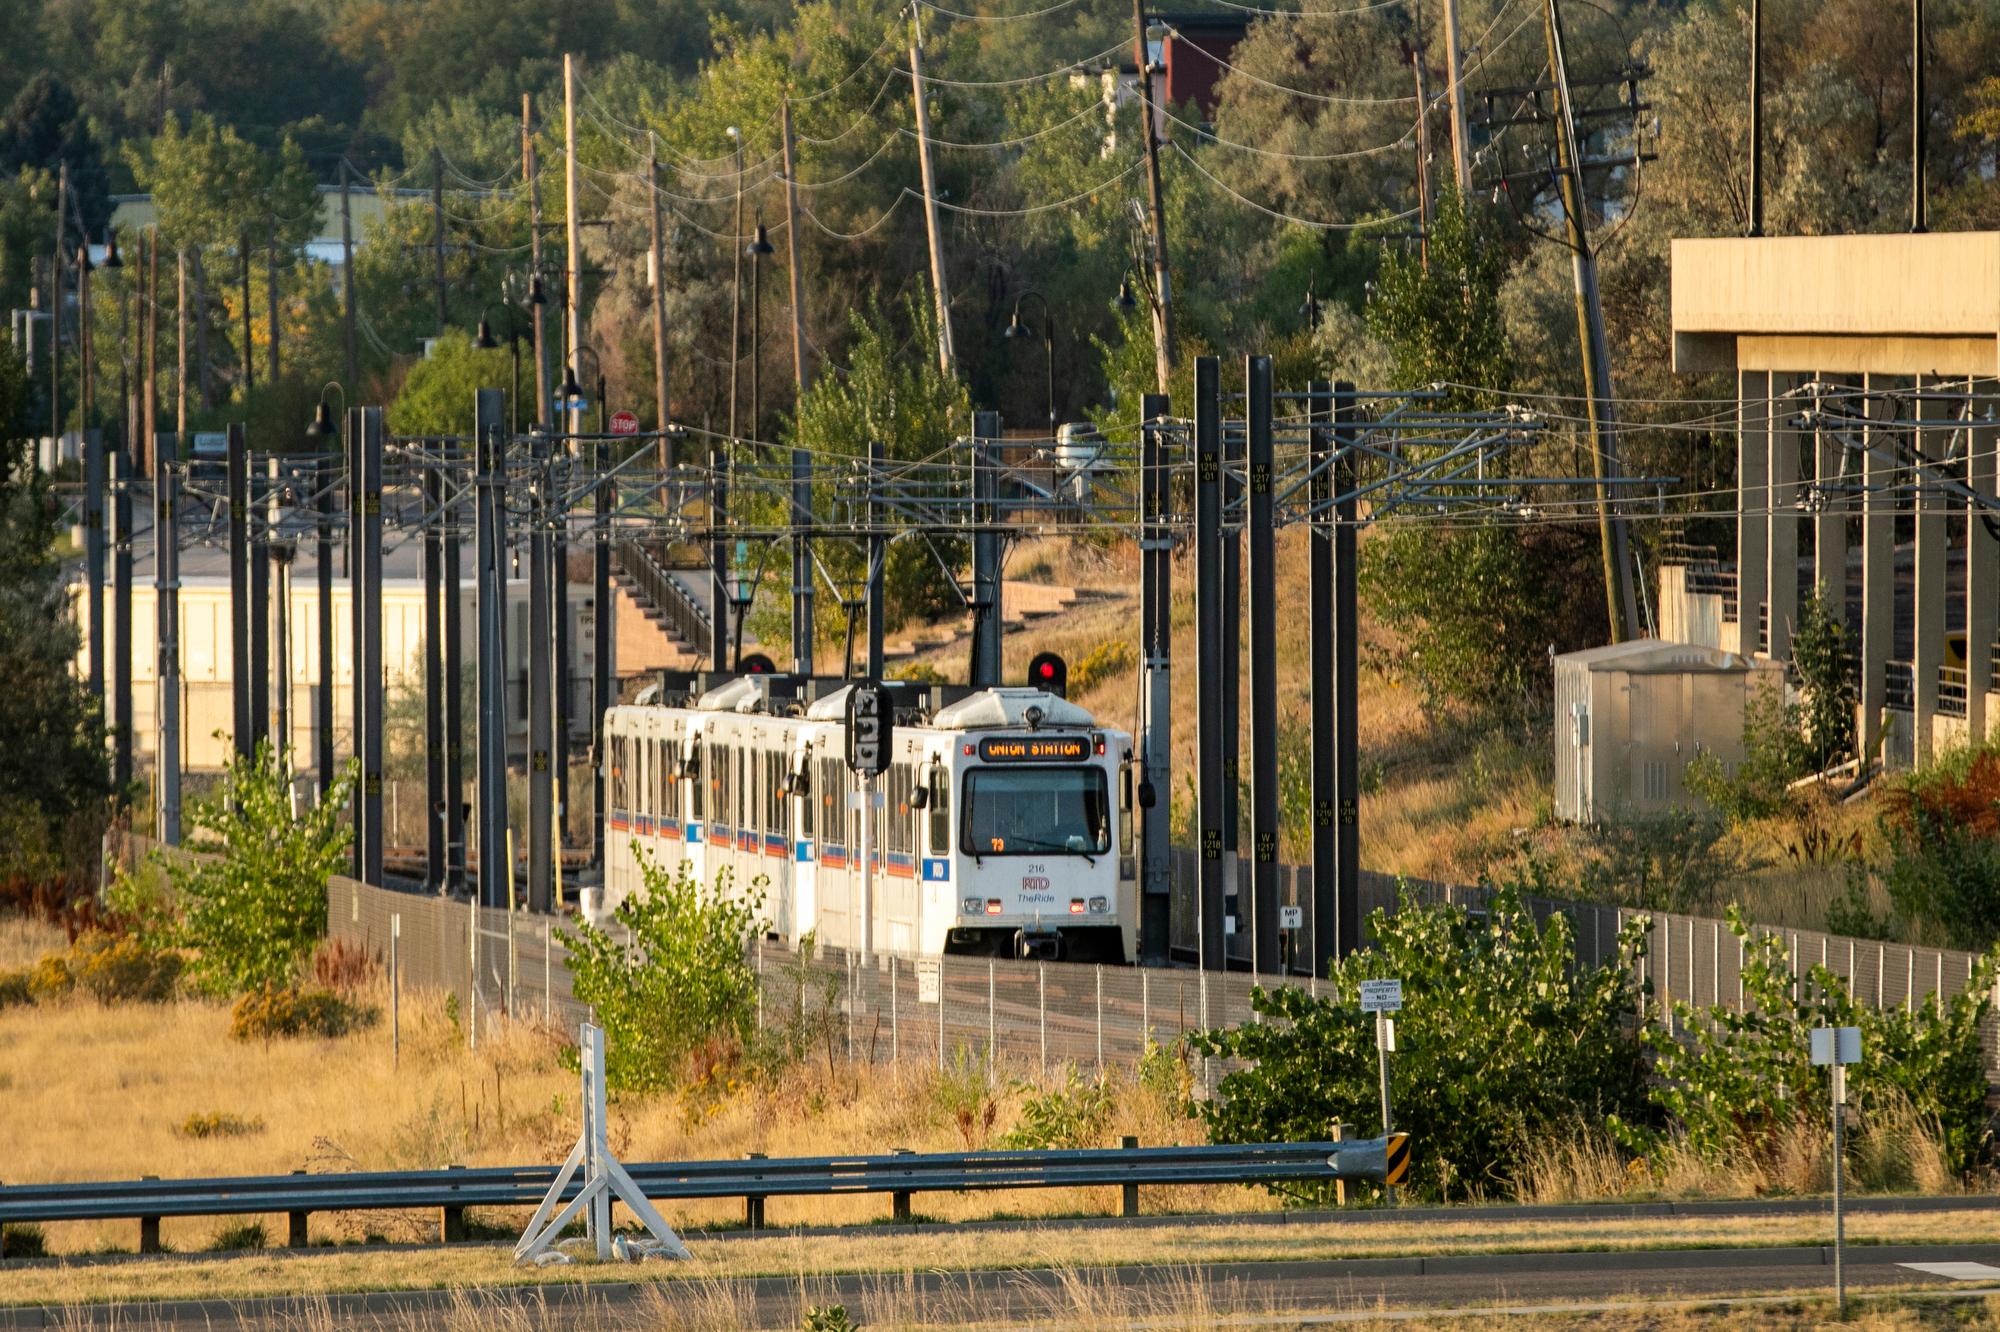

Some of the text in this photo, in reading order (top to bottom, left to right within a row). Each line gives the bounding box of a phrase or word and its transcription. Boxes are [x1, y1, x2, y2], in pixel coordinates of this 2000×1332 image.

[611, 418, 637, 432] STOP
[1204, 453, 1213, 461] W
[1256, 464, 1265, 473] W
[1253, 473, 1270, 482] 1217
[988, 743, 1081, 756] UNION STATION
[1320, 800, 1328, 808] W
[1343, 799, 1352, 807] W
[1207, 831, 1217, 840] W
[1261, 833, 1271, 842] W
[1257, 843, 1275, 852] 1217
[1028, 864, 1045, 873] 216
[1022, 877, 1050, 891] RTD
[1018, 893, 1055, 903] TheRide
[1284, 908, 1298, 917] MP
[1364, 1001, 1400, 1009] TRESPASSING
